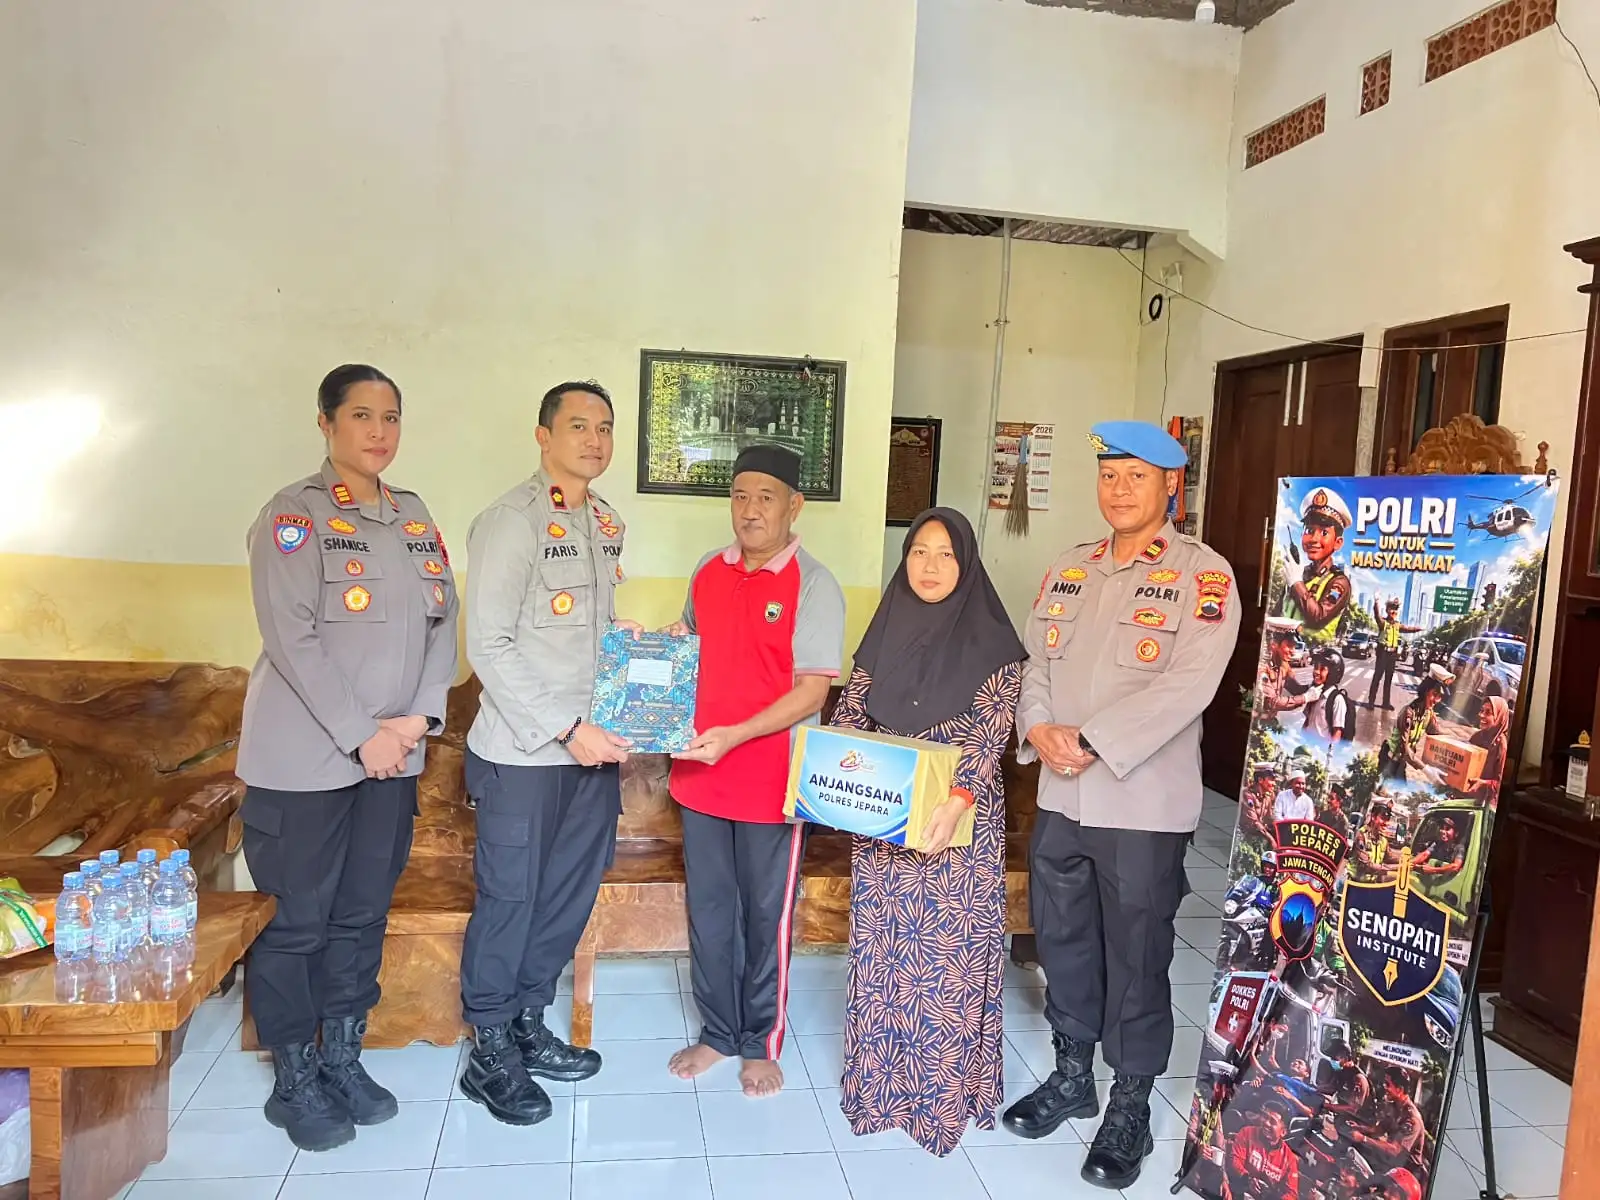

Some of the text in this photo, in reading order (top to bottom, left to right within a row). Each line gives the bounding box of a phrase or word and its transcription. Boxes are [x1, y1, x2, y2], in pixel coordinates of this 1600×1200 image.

[1035, 426, 1053, 434] 2026
[1357, 497, 1457, 536] POLRI
[323, 537, 370, 552] SHANICE
[406, 541, 438, 553] POLRI
[1379, 535, 1427, 552] UNTUK
[544, 545, 578, 559] FARIS
[1350, 551, 1456, 573] MASYARAKAT
[1050, 582, 1082, 595] ANDI
[1135, 587, 1180, 602] POLRI
[809, 773, 903, 806] ANJANGSANA
[819, 792, 889, 816] POLRES JEPARA
[1290, 823, 1340, 849] POLRES
[1292, 836, 1336, 860] JEPARA
[1282, 857, 1307, 869] JAWA
[1347, 907, 1441, 957] SENOPATI
[1356, 934, 1427, 969] INSTITUTE
[1231, 984, 1257, 999] DOKKES
[1230, 995, 1250, 1011] POLRI
